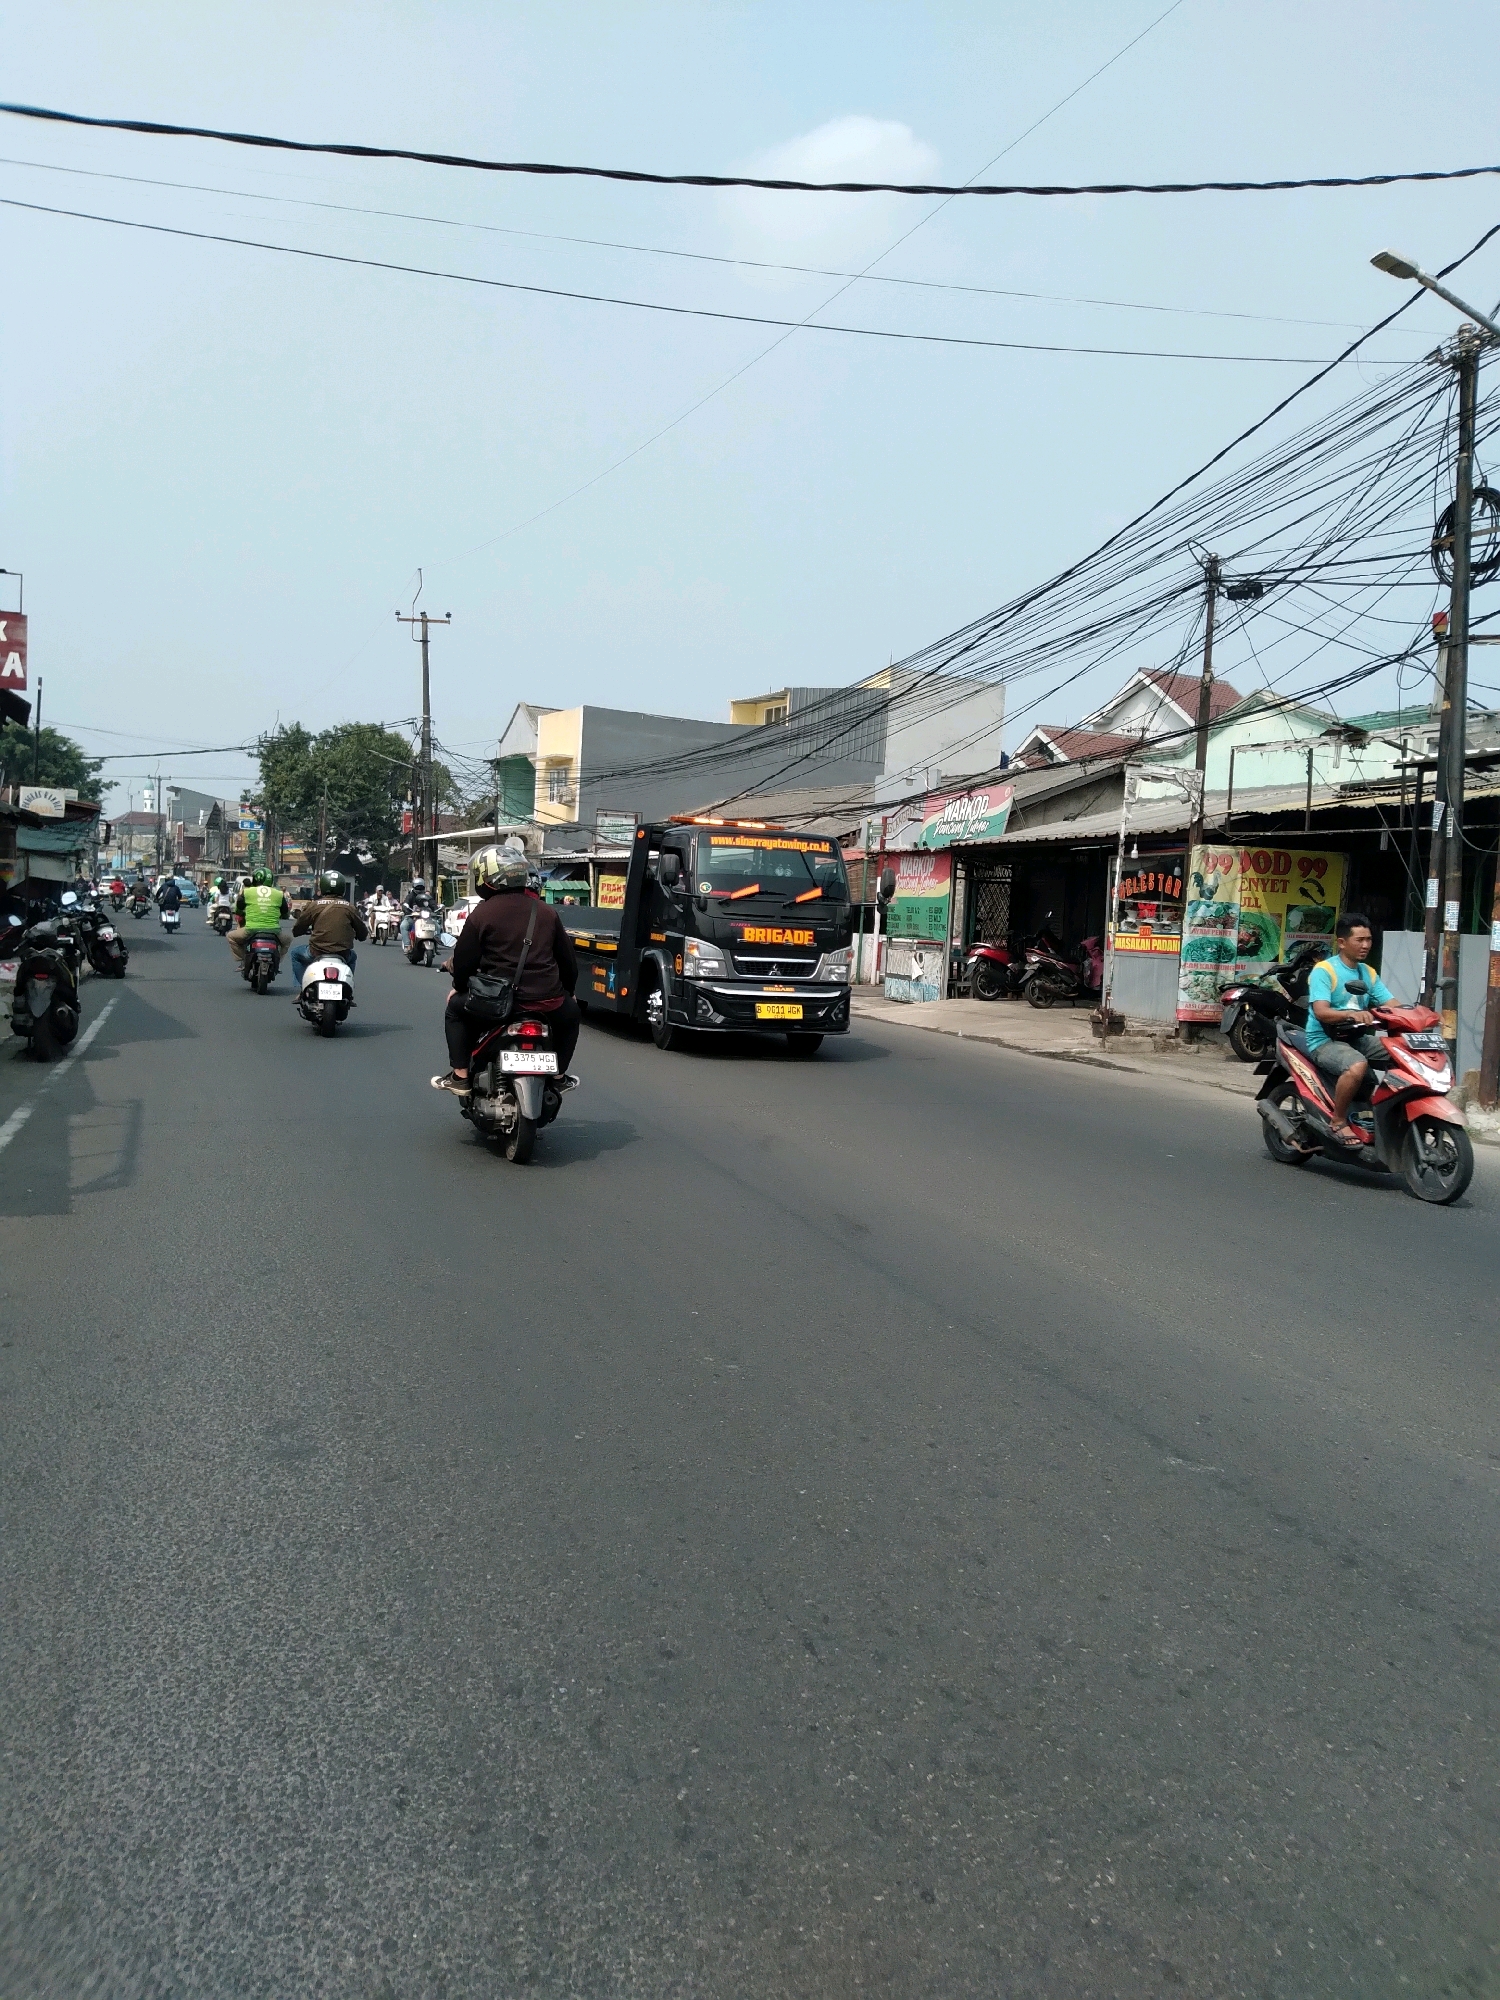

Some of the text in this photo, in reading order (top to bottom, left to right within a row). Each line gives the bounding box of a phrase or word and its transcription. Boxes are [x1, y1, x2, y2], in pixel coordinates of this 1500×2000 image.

[944, 795, 989, 821] WARKOP
[710, 836, 830, 853] www.sinarrayatowing.co.id
[900, 854, 936, 877] WARKOP
[1203, 852, 1233, 875] 99
[1298, 857, 1328, 879] 99
[744, 927, 814, 944] BRIGADE
[1115, 937, 1151, 951] MASAKAN
[756, 1005, 762, 1014] B
[503, 1053, 509, 1061] B
[514, 1053, 536, 1062] 3375
